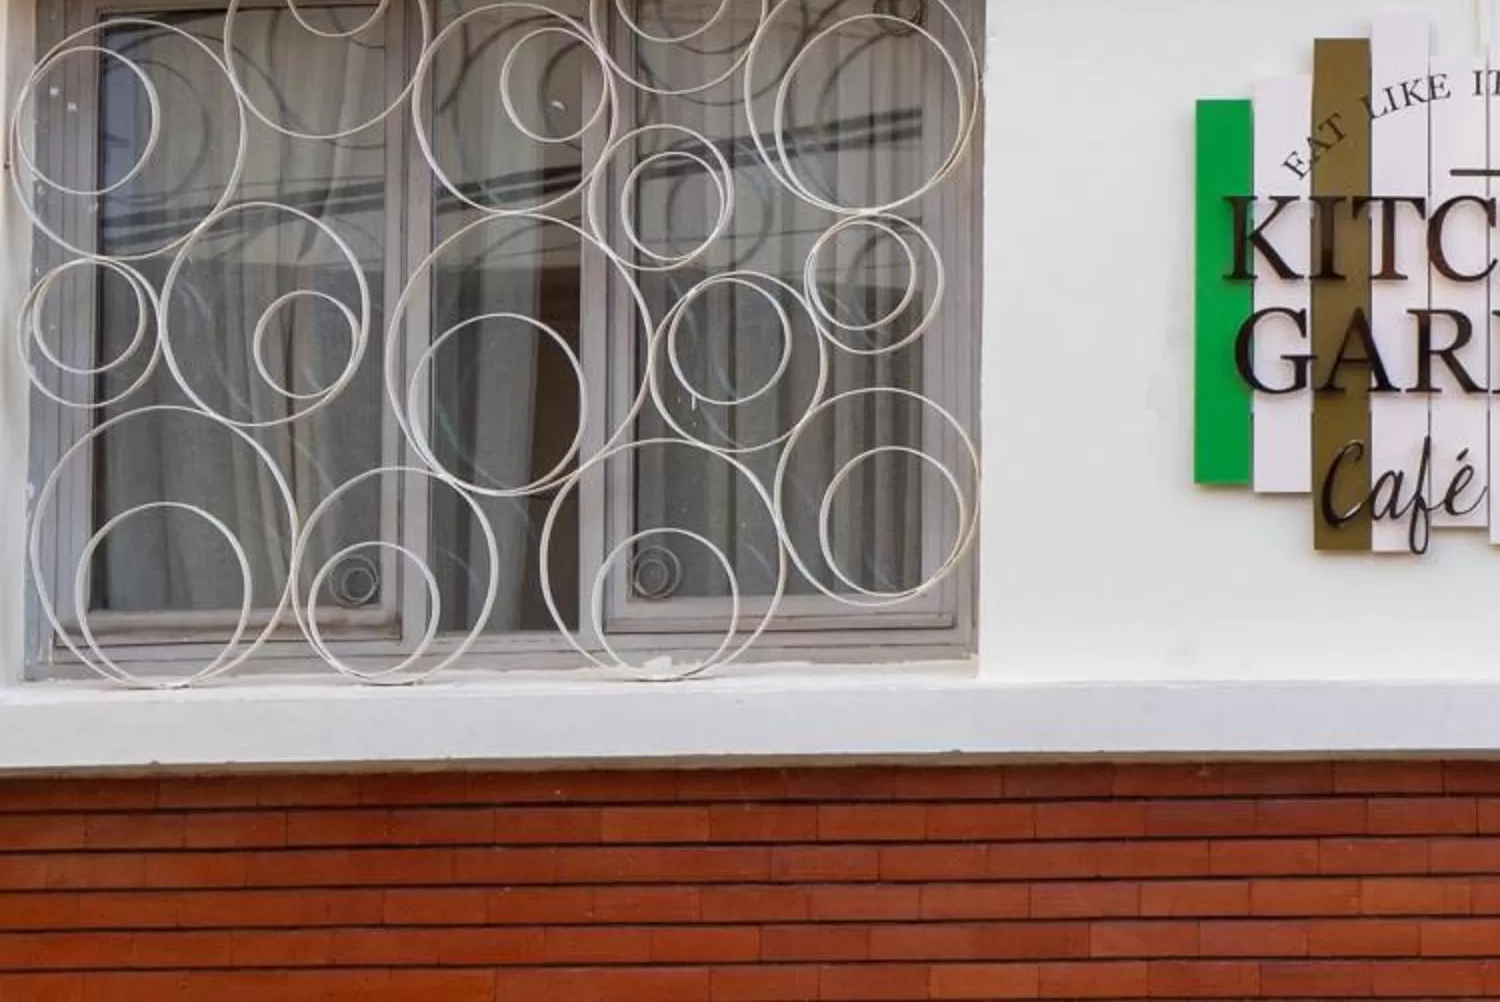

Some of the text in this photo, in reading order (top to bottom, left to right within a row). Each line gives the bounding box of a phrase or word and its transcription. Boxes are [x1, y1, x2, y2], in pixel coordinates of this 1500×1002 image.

[1282, 112, 1348, 181] EAT
[1360, 72, 1452, 121] LIKE
[1320, 435, 1489, 556] Café
